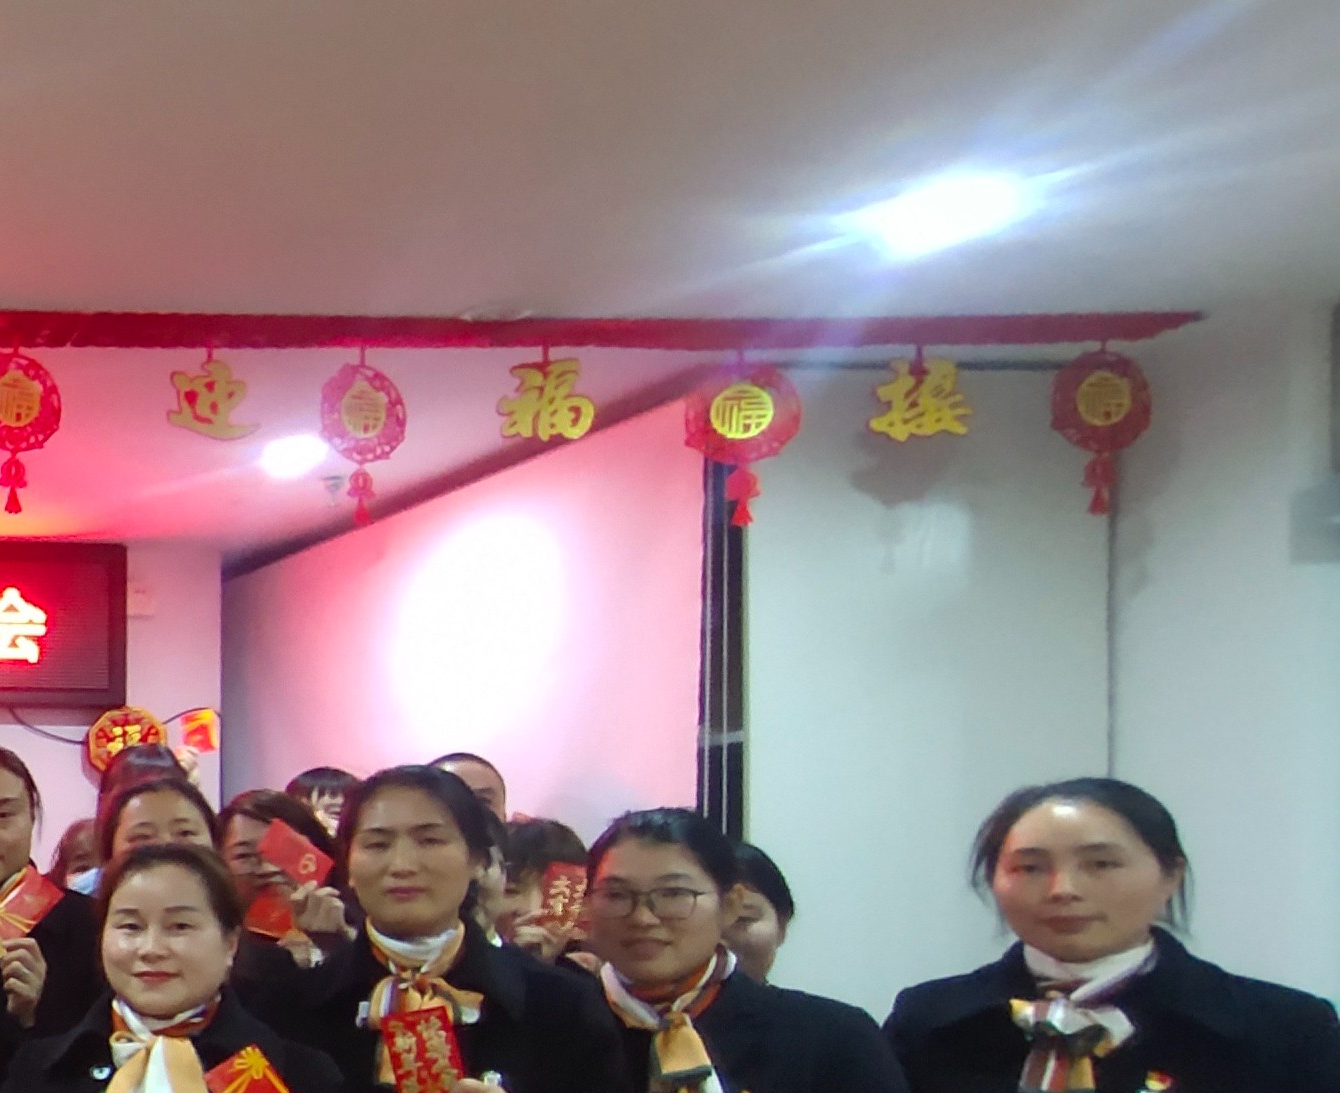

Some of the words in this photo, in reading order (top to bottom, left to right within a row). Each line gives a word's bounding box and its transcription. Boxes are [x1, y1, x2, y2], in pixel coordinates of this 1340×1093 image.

[166, 360, 260, 439] 迎
[499, 360, 595, 441] 福
[710, 385, 774, 438] 福
[868, 360, 973, 441] 接
